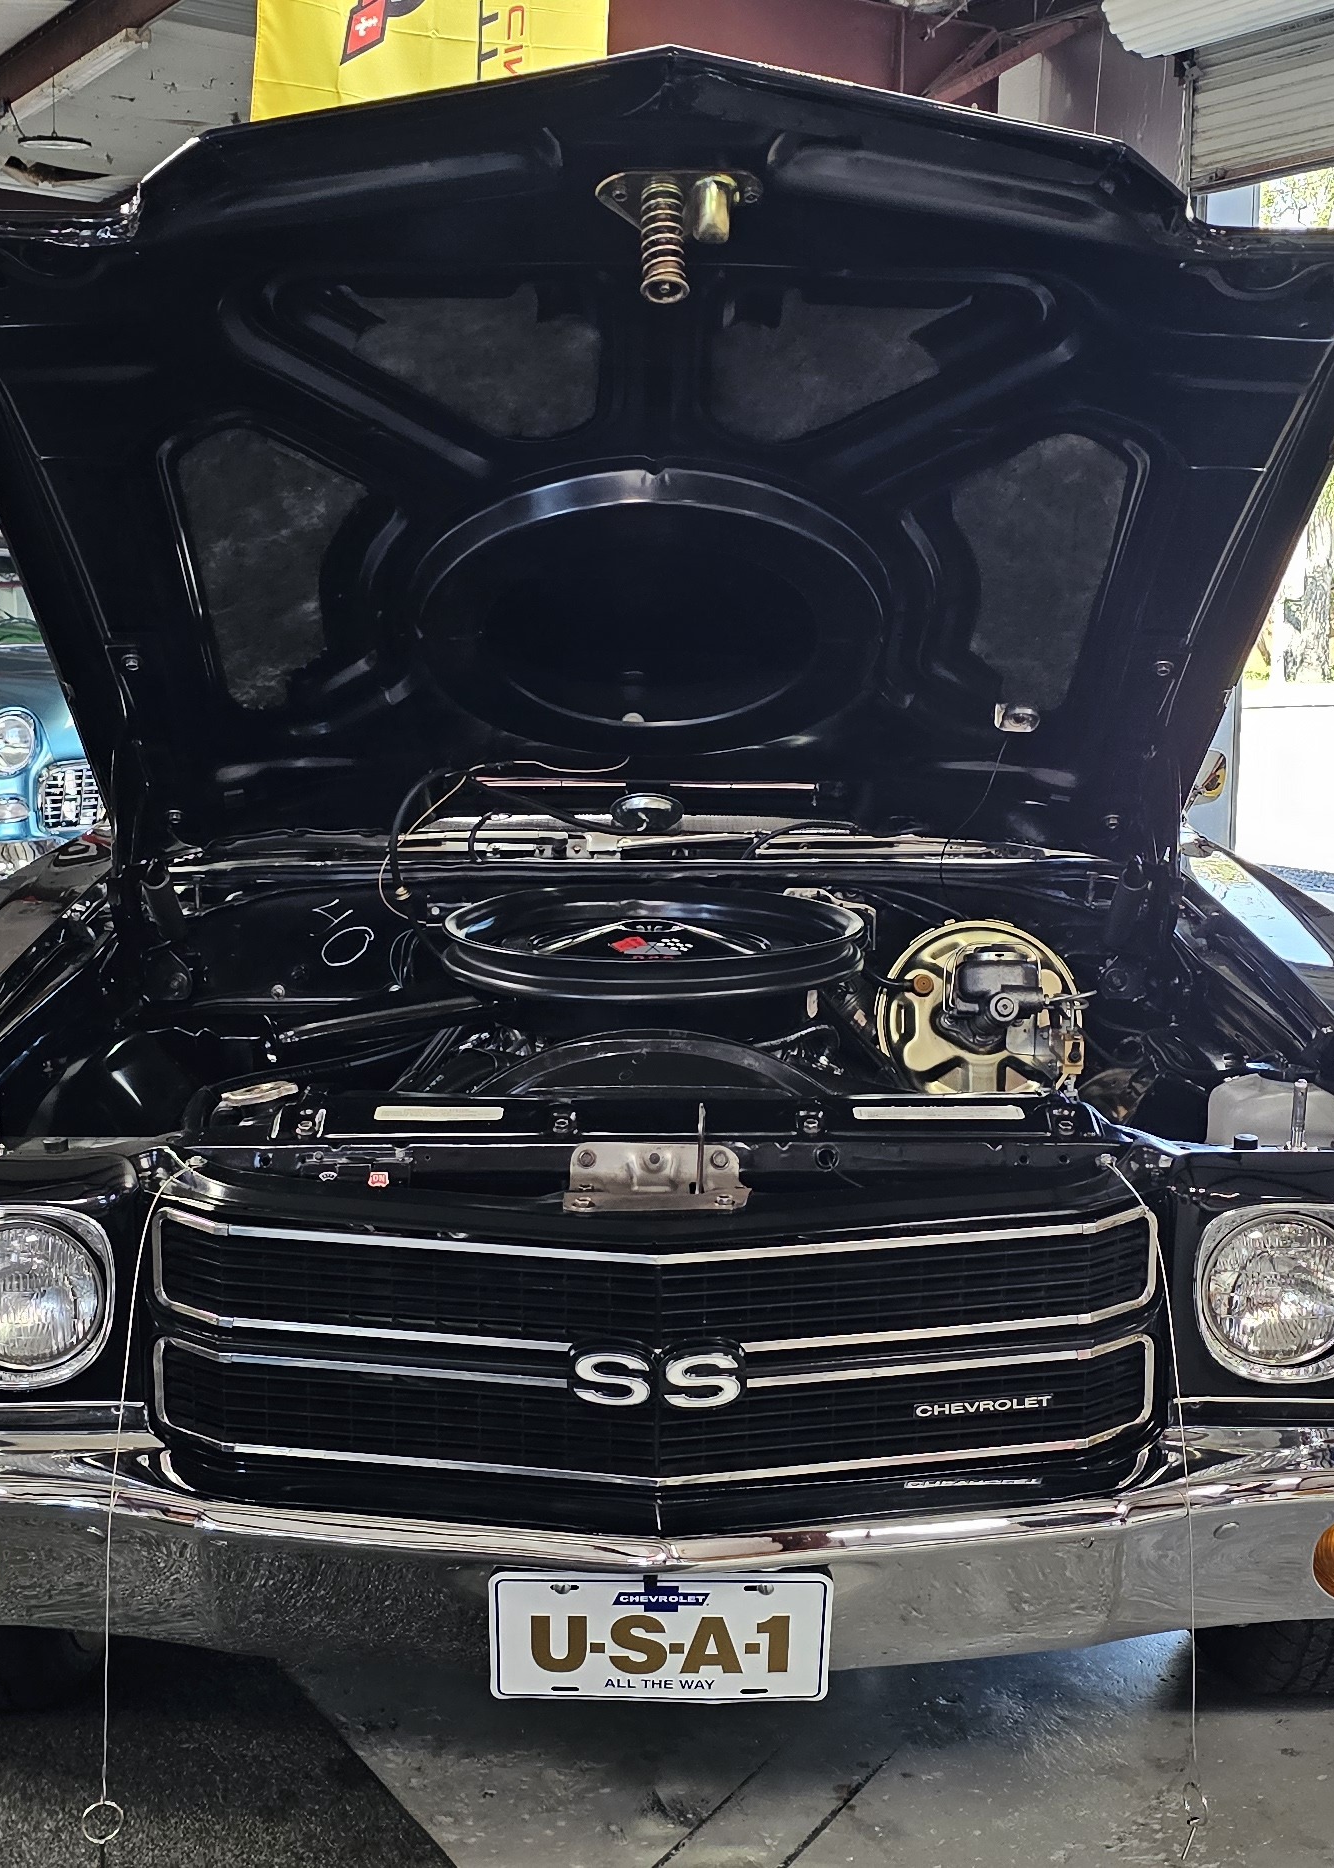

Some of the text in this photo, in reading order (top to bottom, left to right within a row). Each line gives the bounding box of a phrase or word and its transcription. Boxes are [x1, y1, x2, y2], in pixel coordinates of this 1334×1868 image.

[574, 1352, 742, 1408] SS
[915, 1395, 1053, 1418] CHEVROLET
[619, 1594, 706, 1604] CHEVROLET
[530, 1614, 791, 1675] U-S-A-1
[604, 1677, 715, 1691] ALL THE WAY
